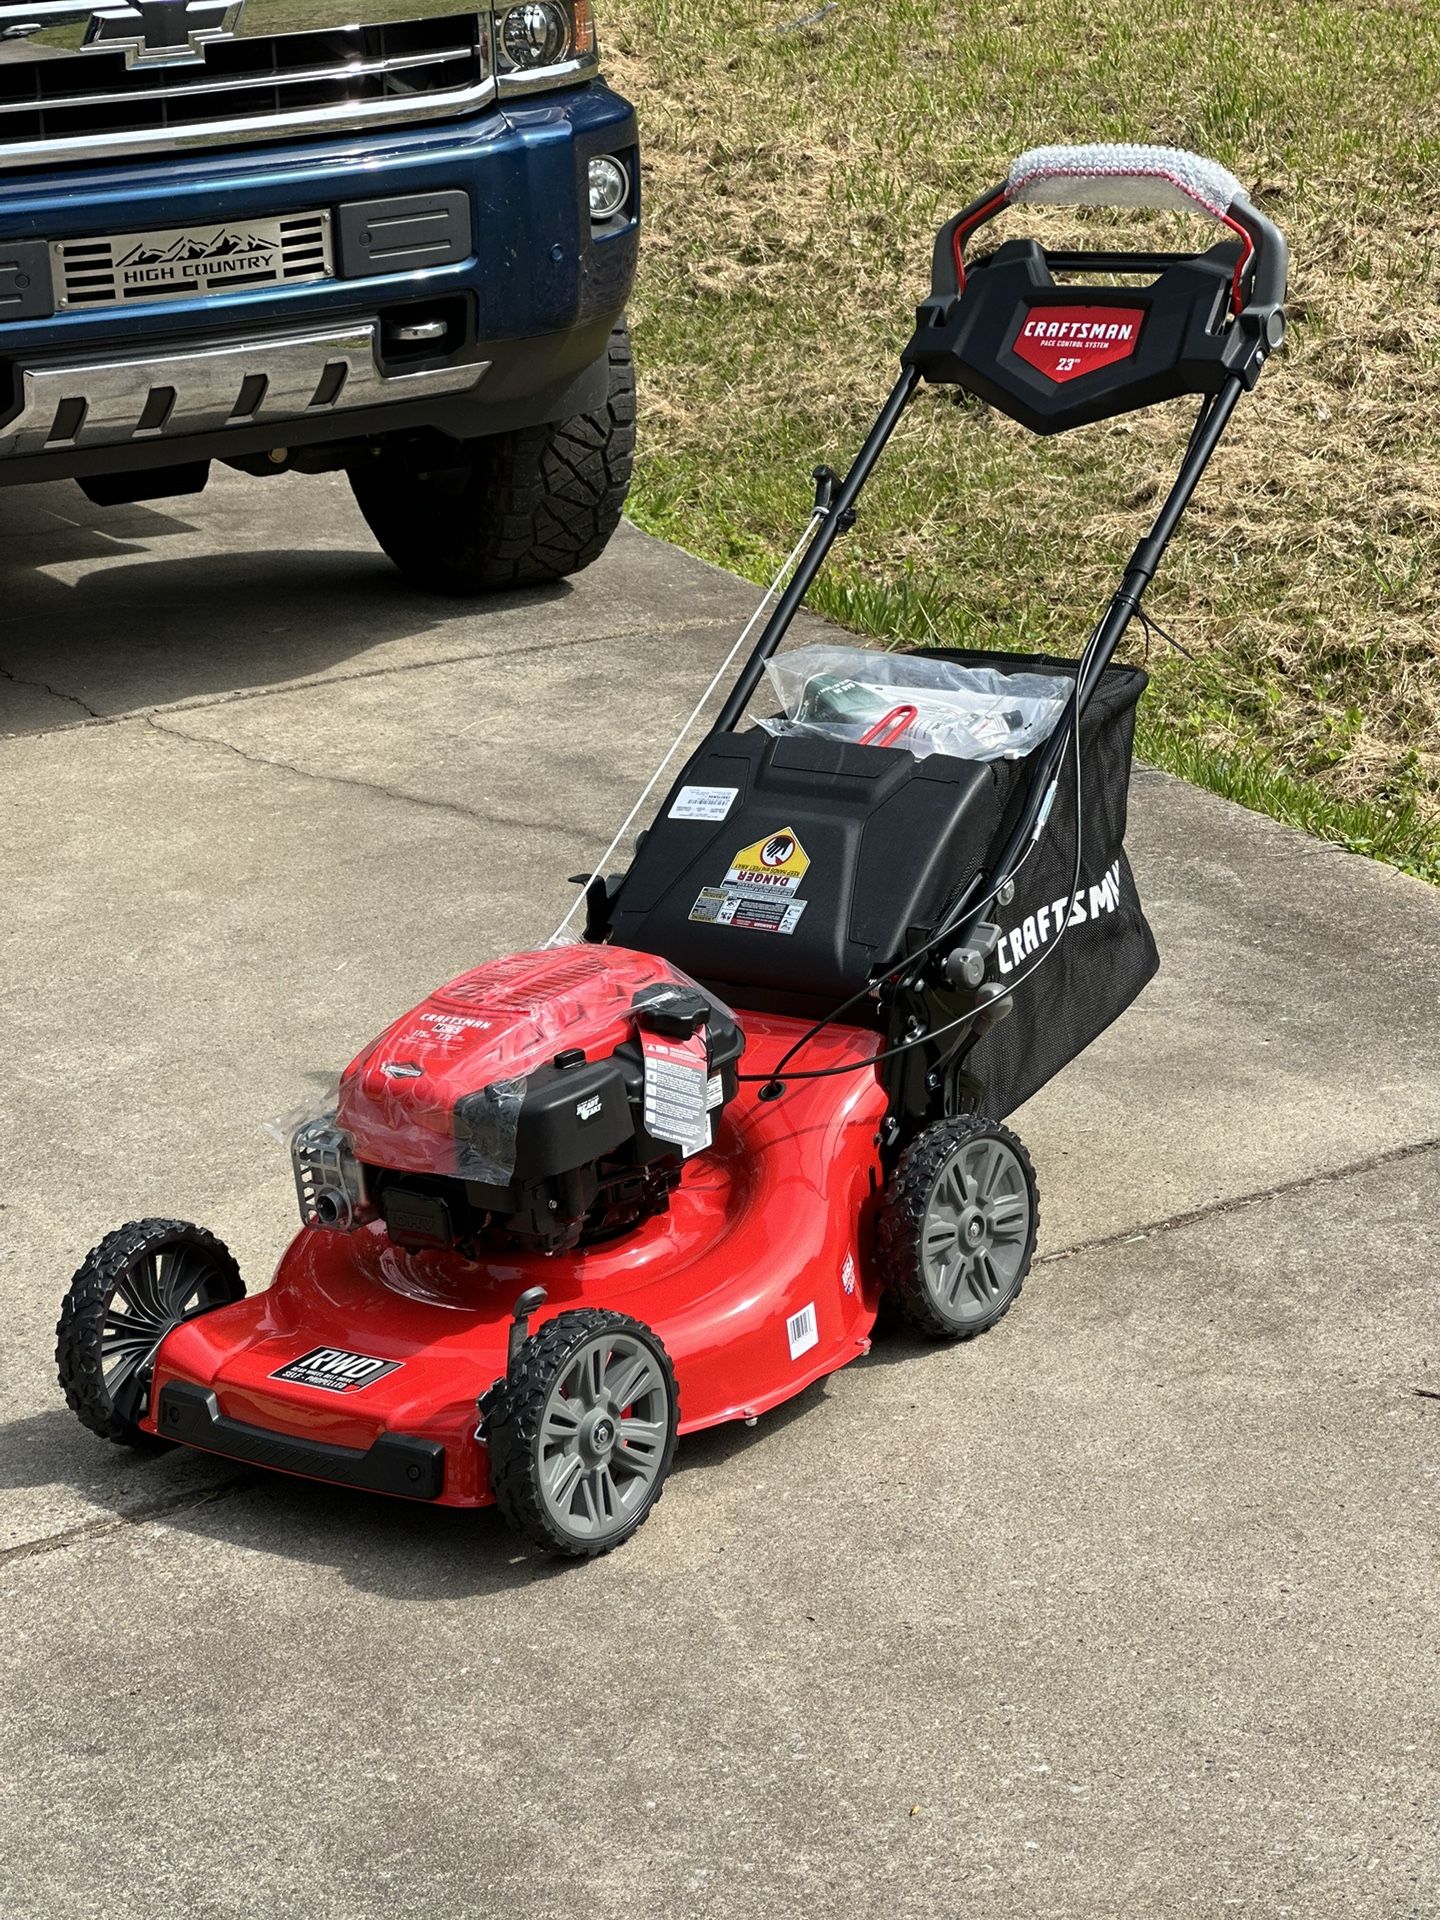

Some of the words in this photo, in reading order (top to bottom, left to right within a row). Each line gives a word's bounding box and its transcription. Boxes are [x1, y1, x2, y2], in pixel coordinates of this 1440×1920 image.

[124, 266, 175, 284] HIGH
[182, 254, 273, 277] COUNTRY
[1024, 321, 1133, 340] CRAFTSMAN
[1056, 340, 1083, 348] CONTROL
[1084, 341, 1109, 349] SYSTEM
[737, 871, 790, 886] DANGER
[997, 859, 1120, 974] CRAFTSM
[420, 1013, 493, 1030] CRAFTSMAN
[299, 1349, 384, 1379] RWD
[282, 1370, 301, 1379] SELF
[305, 1374, 348, 1390] PROPELLED
